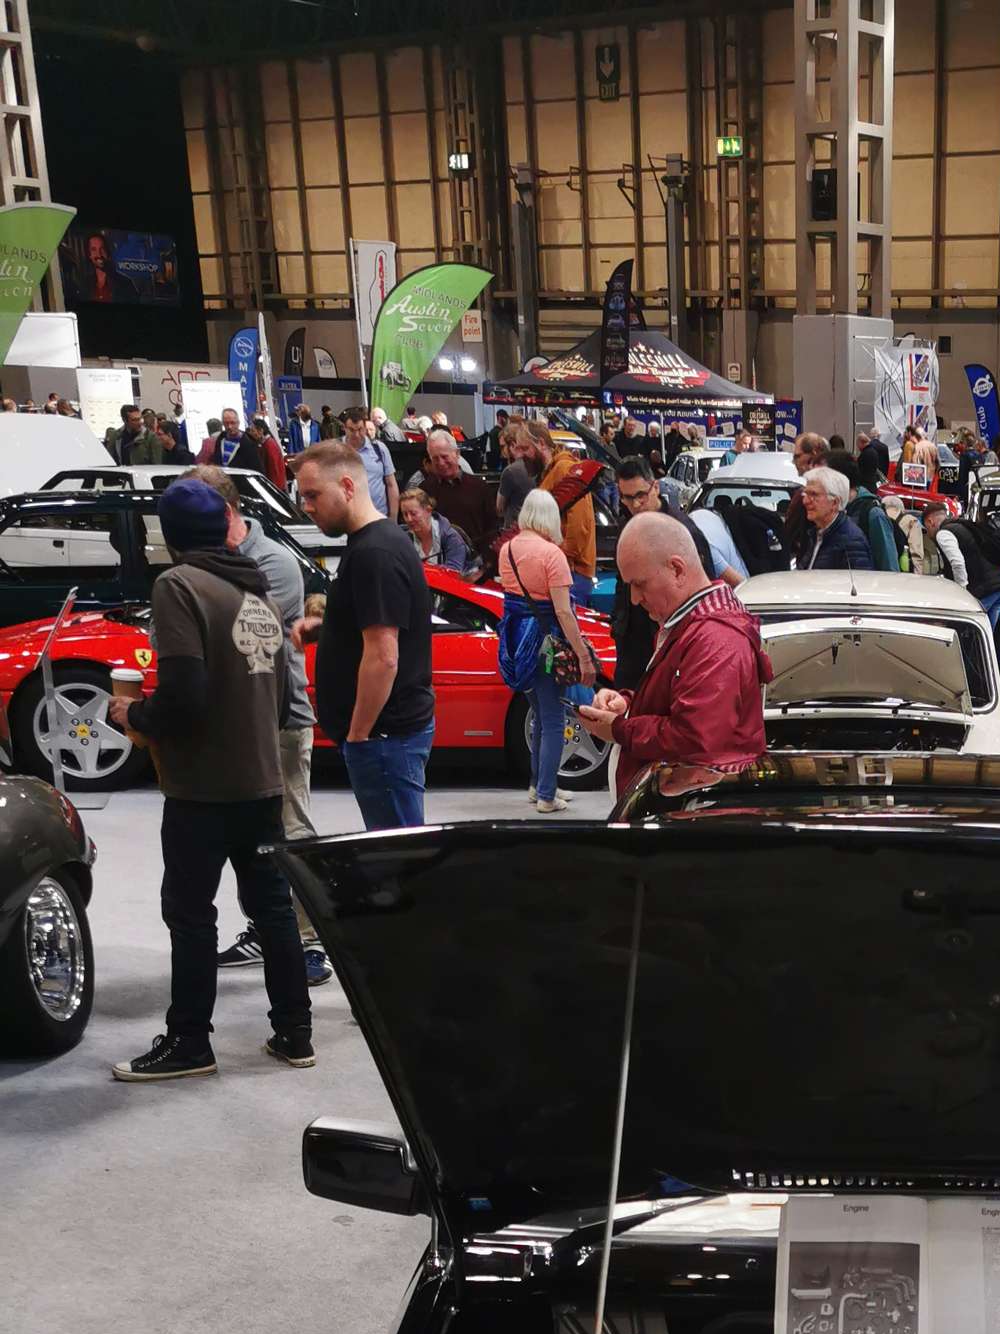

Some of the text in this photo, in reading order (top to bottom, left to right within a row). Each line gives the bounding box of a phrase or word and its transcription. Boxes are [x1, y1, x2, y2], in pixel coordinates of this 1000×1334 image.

[0, 246, 48, 264] LANDS
[118, 261, 159, 273] WORKSHOP
[414, 285, 465, 308] MIDLANDS
[385, 295, 452, 323] Austin
[398, 315, 453, 333] Seven
[464, 314, 478, 324] Fire
[463, 327, 480, 337] point
[977, 406, 988, 430] Club
[239, 619, 280, 634] TRIUMPH
[843, 1203, 870, 1214] Engine
